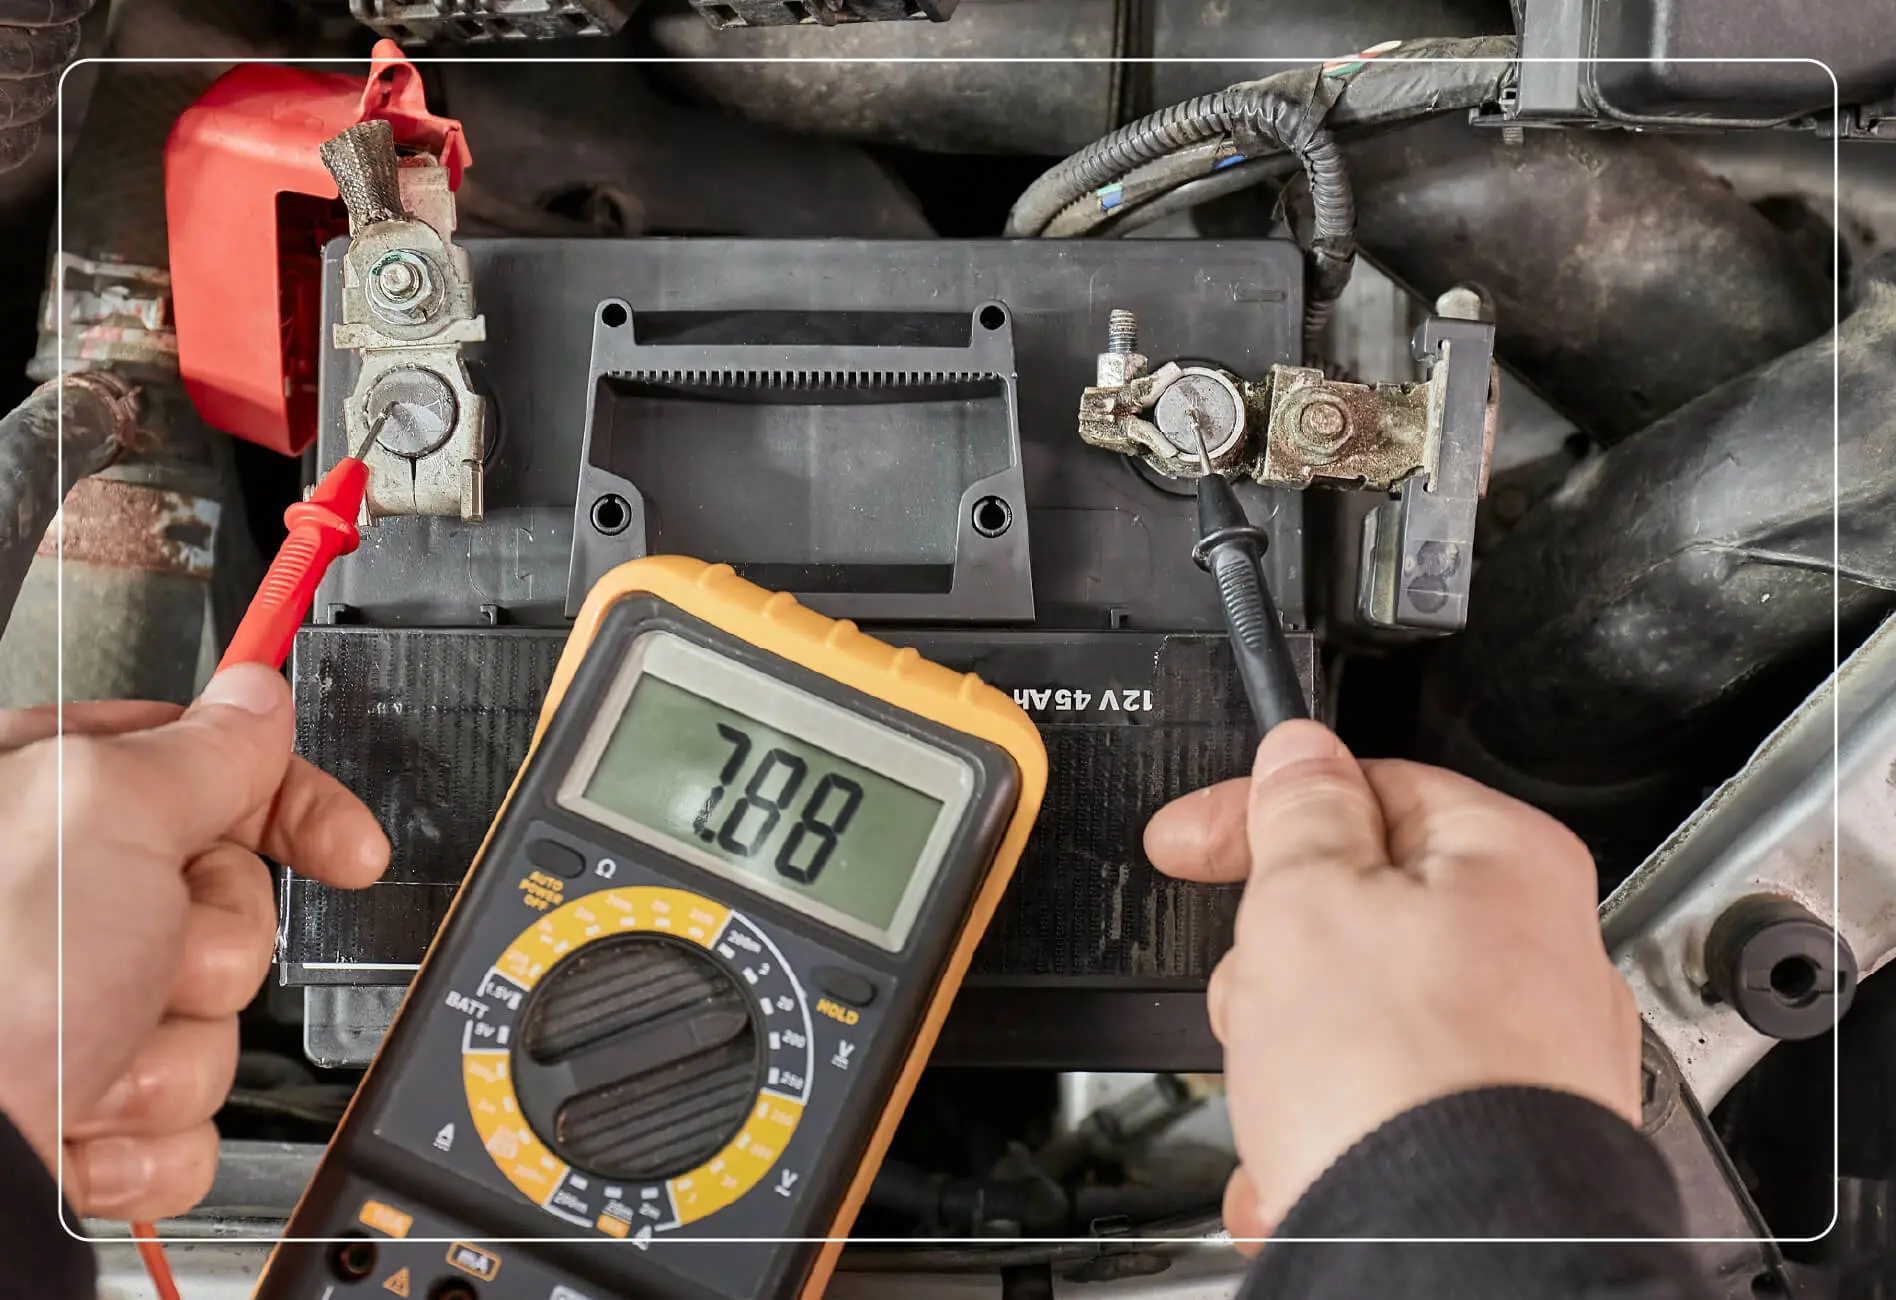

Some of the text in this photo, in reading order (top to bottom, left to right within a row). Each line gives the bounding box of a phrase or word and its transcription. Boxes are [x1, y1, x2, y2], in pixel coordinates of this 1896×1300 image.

[1013, 688, 1153, 712] 12V 45Ah
[692, 721, 864, 886] 7.88
[518, 877, 565, 905] POWER
[528, 870, 565, 892] AUTO
[522, 892, 550, 911] OFF
[445, 989, 490, 1020] BATT
[816, 998, 859, 1025] HOLD
